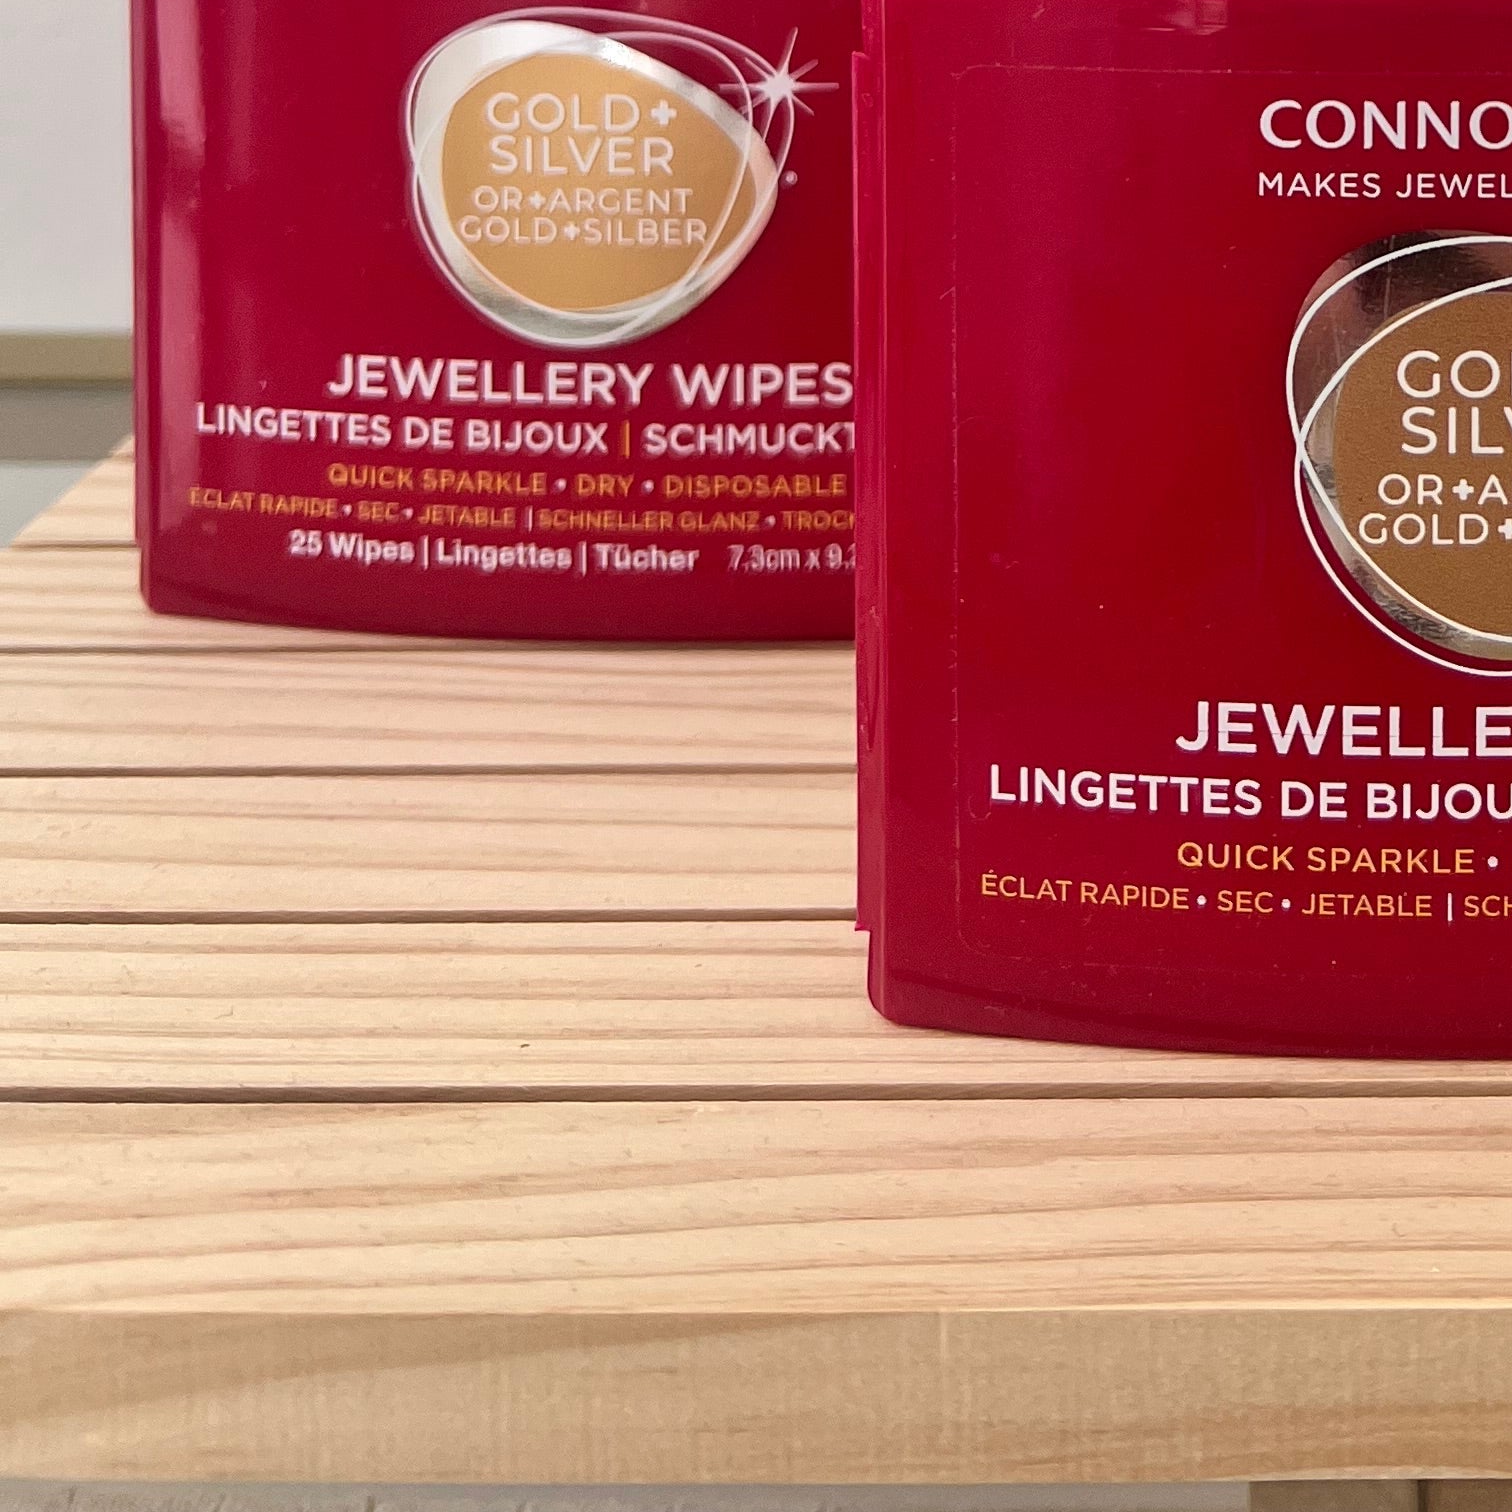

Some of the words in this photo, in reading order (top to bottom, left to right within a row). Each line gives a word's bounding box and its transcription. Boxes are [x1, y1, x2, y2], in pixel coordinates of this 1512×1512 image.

[489, 135, 673, 176] SILVER
[1259, 172, 1380, 198] MAKES
[328, 354, 653, 405] JEWELLERY
[672, 362, 853, 405] WIPES
[195, 402, 391, 446] LINGETTES
[403, 417, 453, 448] DE
[465, 419, 607, 453] BIJOUX
[328, 463, 413, 489] QUICK
[421, 469, 545, 495] SPARKLE
[576, 474, 633, 496] DRY
[664, 474, 845, 498] DISPOSABLE
[259, 494, 338, 518] RAPIDE
[358, 501, 399, 521] SEC
[418, 505, 515, 527] JETABLE
[538, 509, 673, 531] SCHNELLER
[678, 511, 759, 532] GLANZ
[290, 529, 322, 555] 25
[328, 532, 414, 565] Wipes
[436, 538, 572, 572] Lingettes
[593, 543, 699, 570] Tücher
[805, 549, 820, 570] x
[991, 764, 1262, 815] LINGETTES
[1282, 781, 1347, 818] DE
[1178, 842, 1294, 870] QUICK
[1308, 847, 1474, 873] SPARKLE
[982, 870, 1072, 901] ÉCLAT
[1081, 882, 1189, 909] RAPIDE
[1218, 890, 1273, 913] SEC
[1302, 892, 1432, 916] JETABLE
